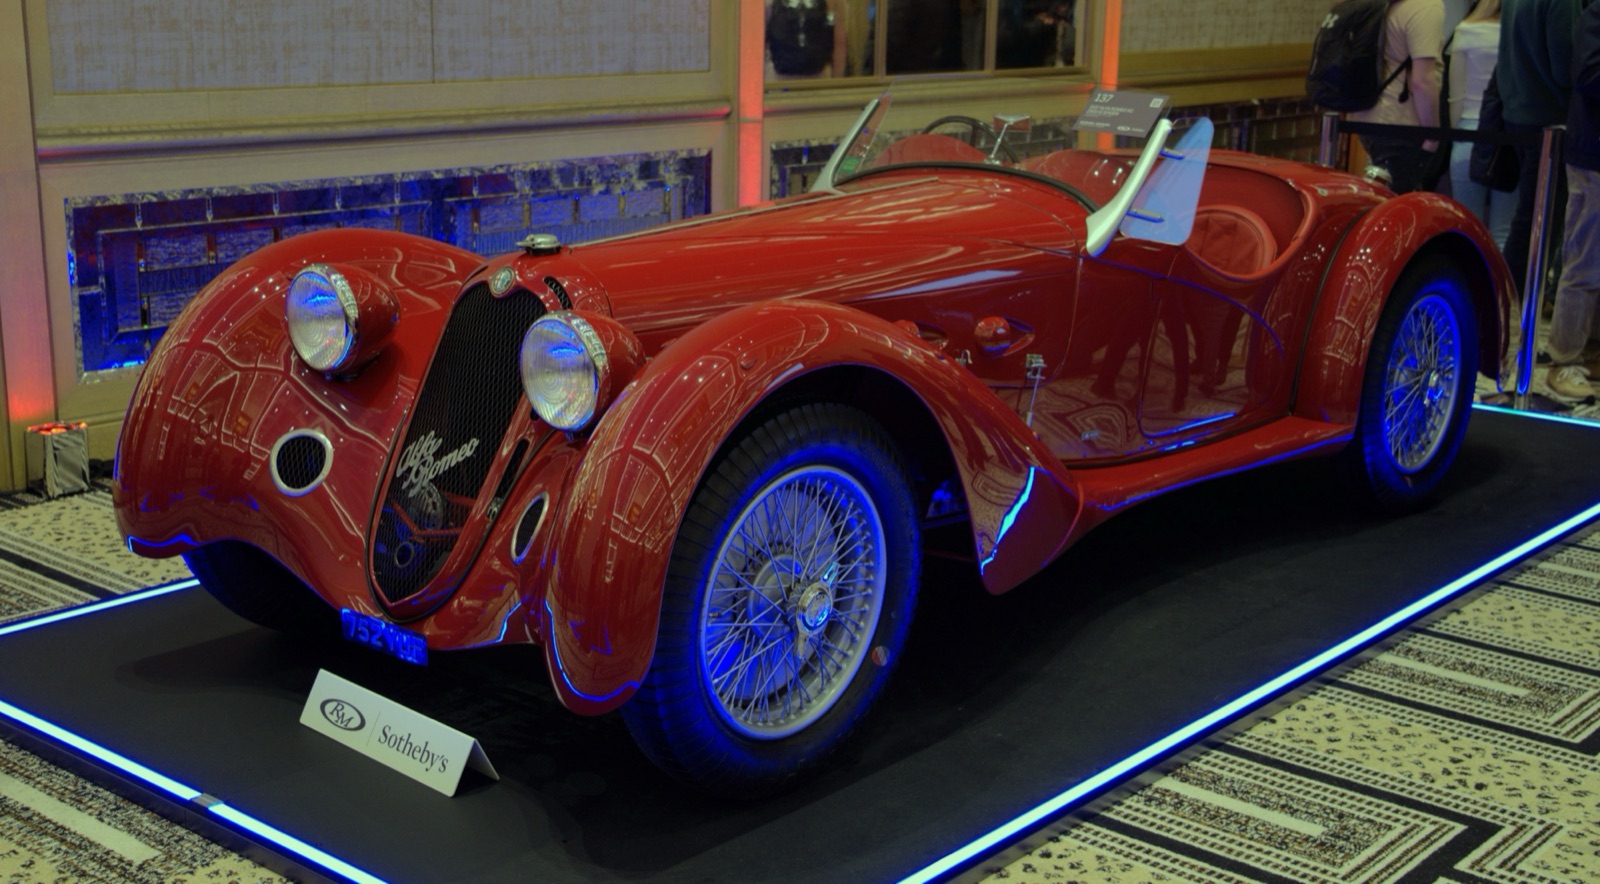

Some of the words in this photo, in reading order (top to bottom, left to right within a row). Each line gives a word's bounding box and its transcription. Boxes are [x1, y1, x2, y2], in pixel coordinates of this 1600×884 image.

[1094, 93, 1114, 103] 137
[396, 430, 443, 490] Alfa
[408, 438, 480, 498] Romeo
[378, 724, 449, 774] Sotheby's
